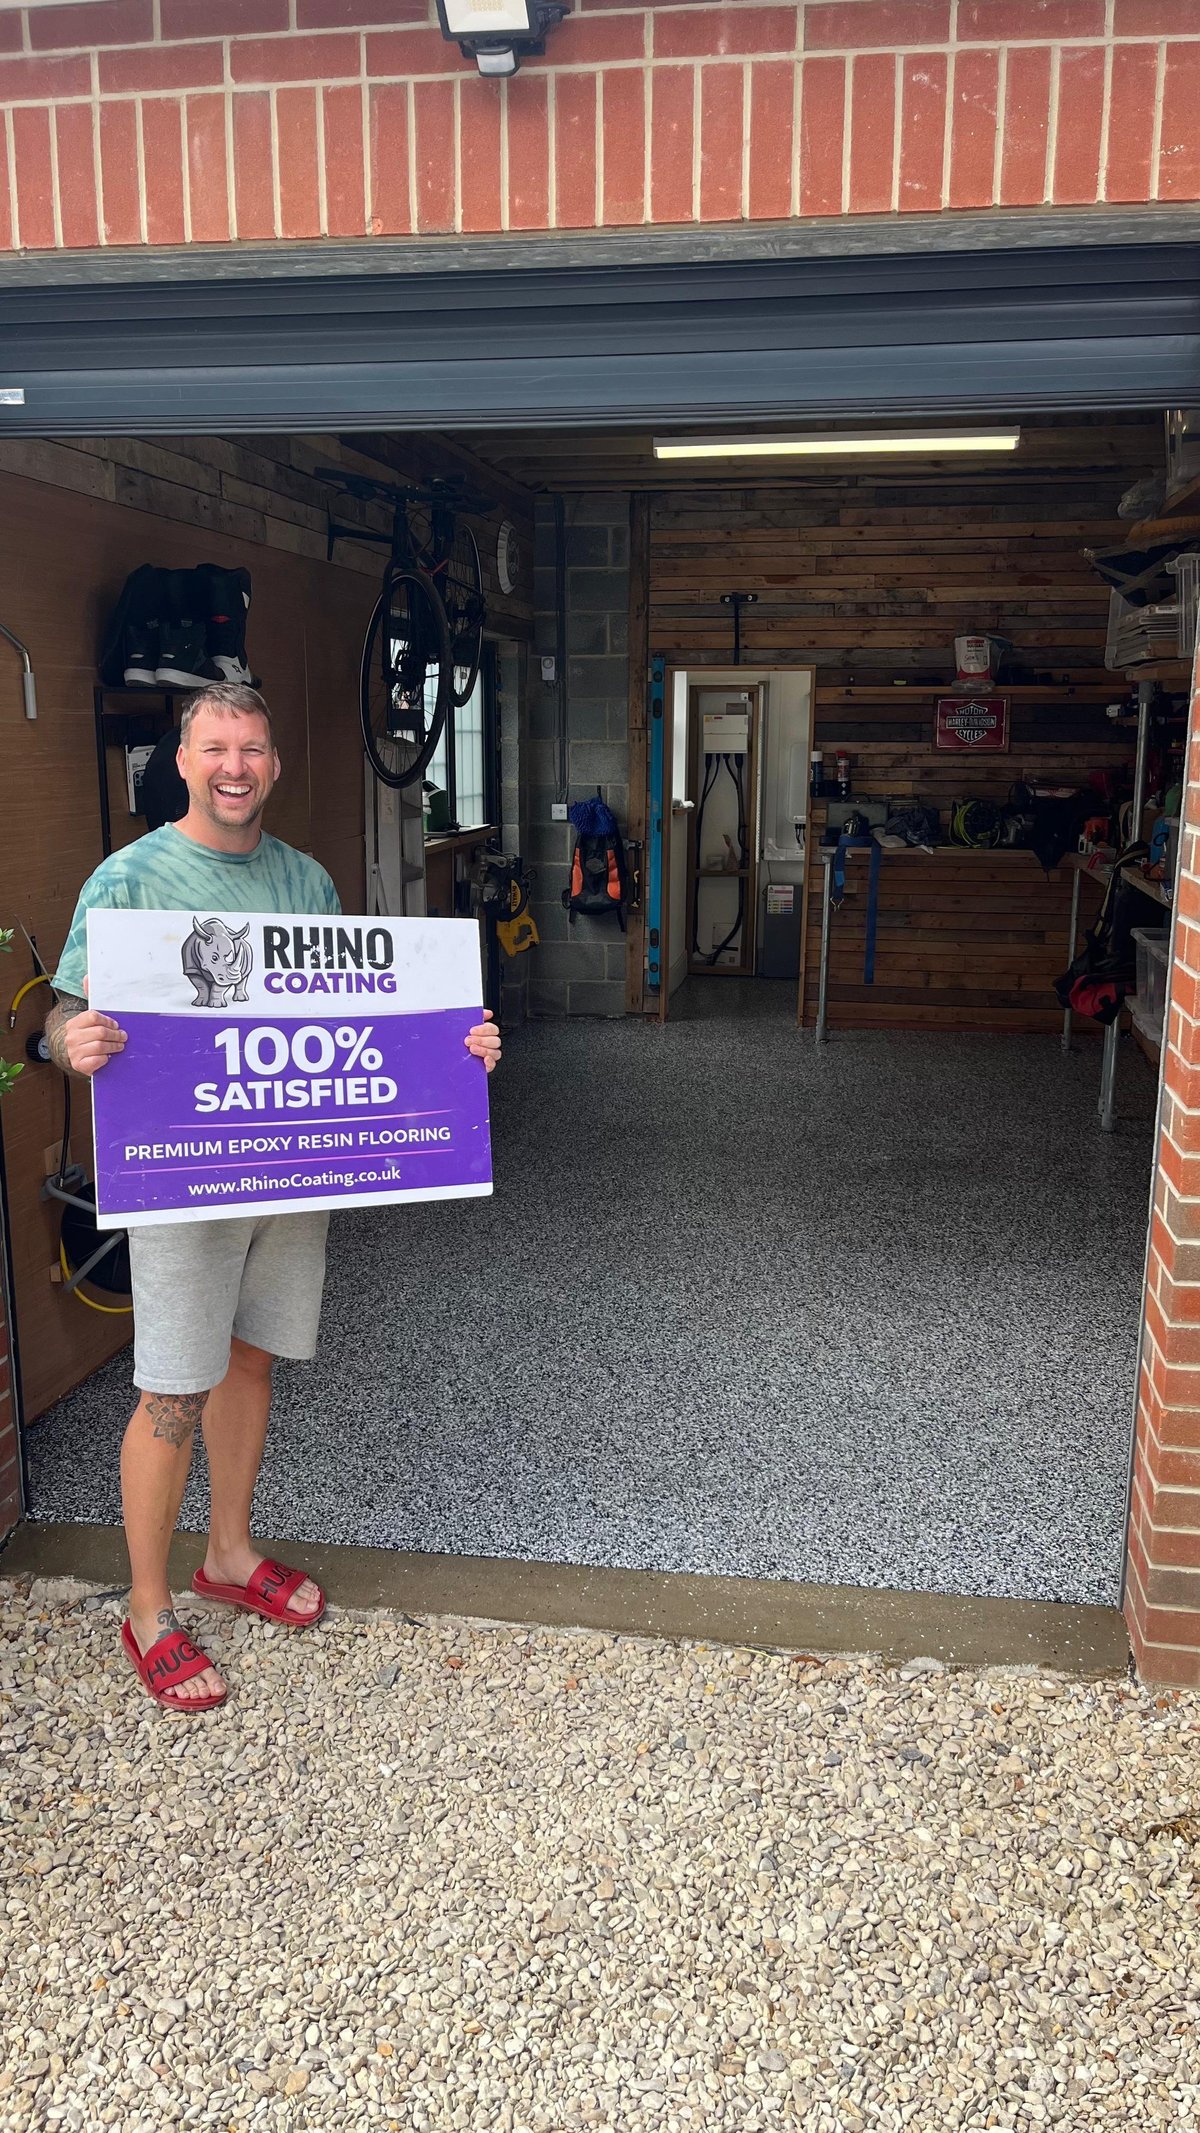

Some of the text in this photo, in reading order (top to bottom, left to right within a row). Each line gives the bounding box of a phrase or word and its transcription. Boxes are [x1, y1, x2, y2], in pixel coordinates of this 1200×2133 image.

[959, 730, 983, 741] CYCLES
[263, 925, 394, 970] RHINO
[263, 972, 397, 994] COATING
[214, 1025, 383, 1076] 100%
[194, 1076, 398, 1113] SATISFIED
[125, 1126, 451, 1161] PREMIUM EPOXY RESIN FLOORING
[188, 1166, 401, 1196] www.RhinoCoating.co.uk
